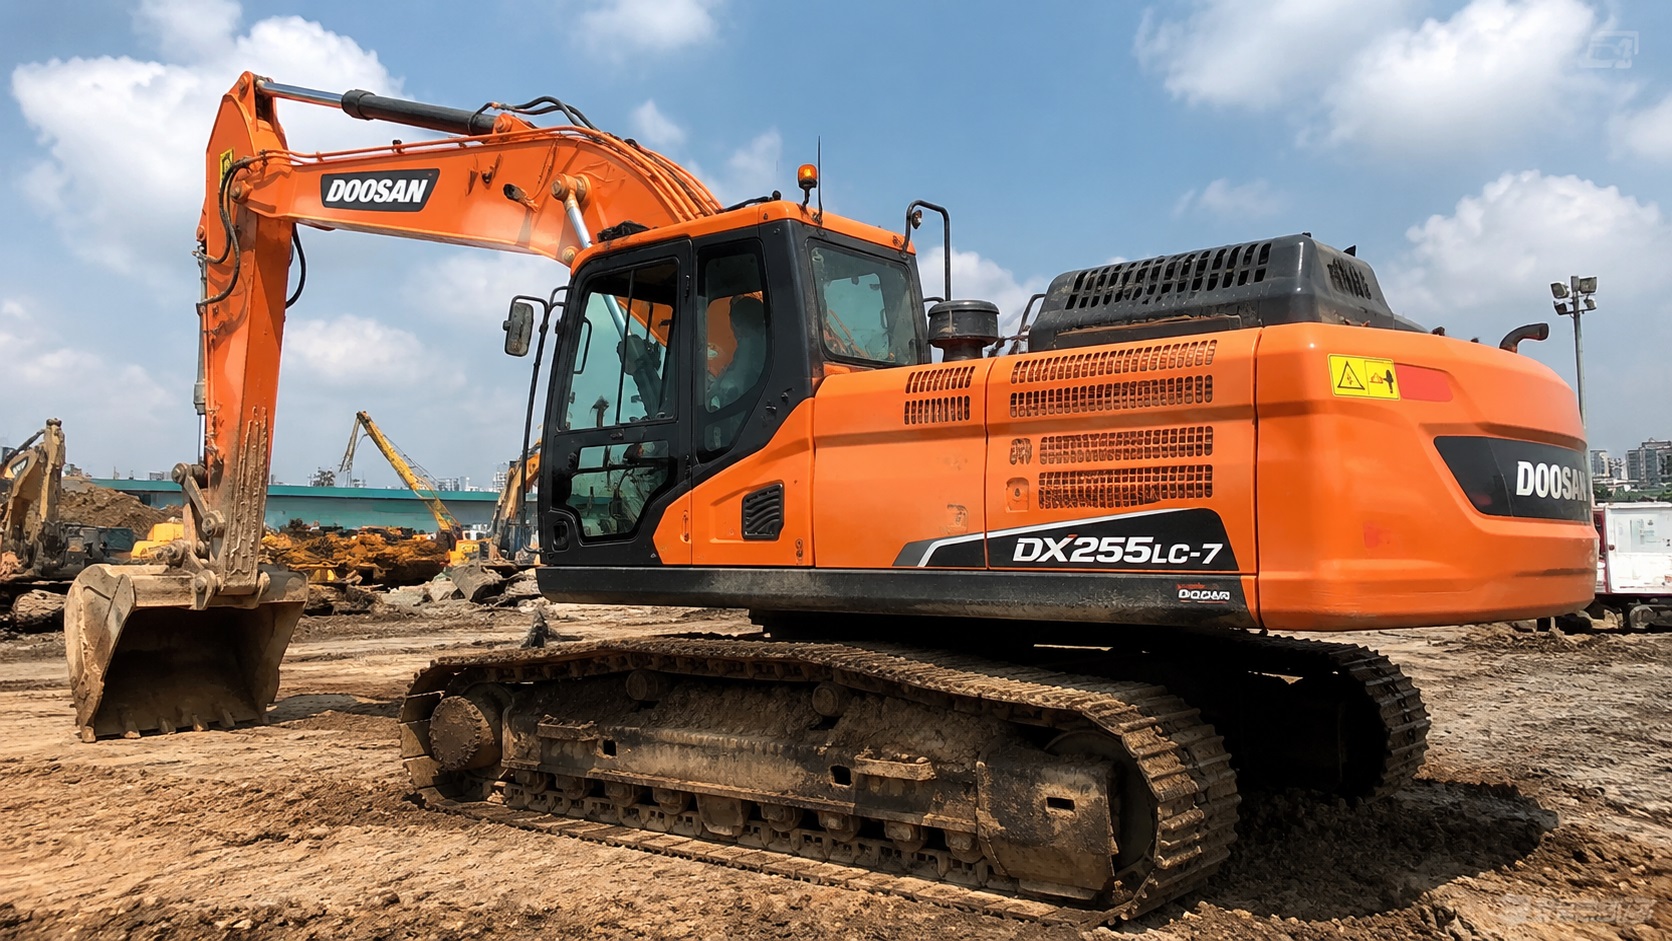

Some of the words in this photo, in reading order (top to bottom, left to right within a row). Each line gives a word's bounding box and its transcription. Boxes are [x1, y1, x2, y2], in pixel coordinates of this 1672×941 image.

[325, 178, 428, 203] DOOSAN
[1516, 461, 1587, 502] DOOSAN
[1012, 535, 1223, 564] DX255LC-7
